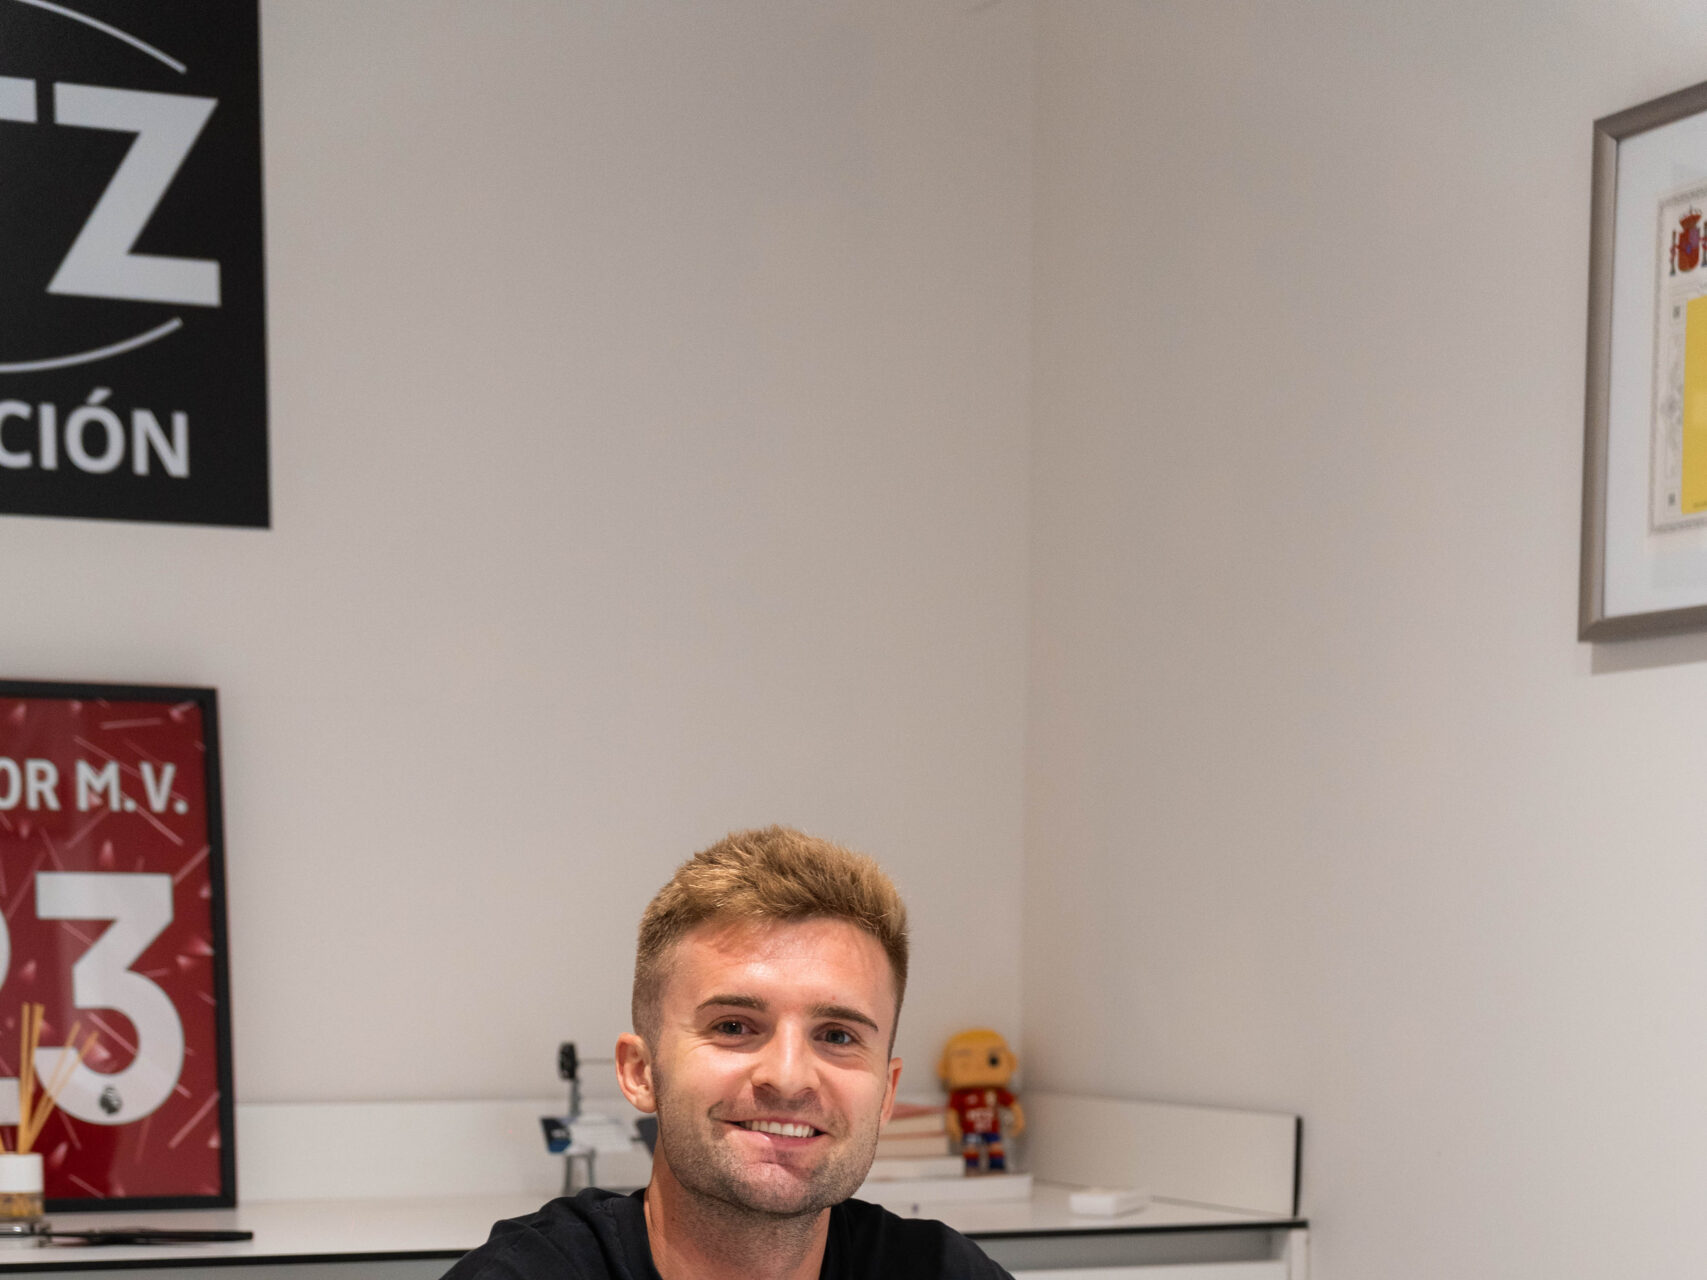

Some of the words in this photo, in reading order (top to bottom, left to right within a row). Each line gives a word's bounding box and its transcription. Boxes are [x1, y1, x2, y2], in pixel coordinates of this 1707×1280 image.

[0, 75, 221, 307] Z
[0, 387, 189, 478] CIÓN
[75, 759, 189, 815] M.V.
[0, 872, 185, 1125] 3
